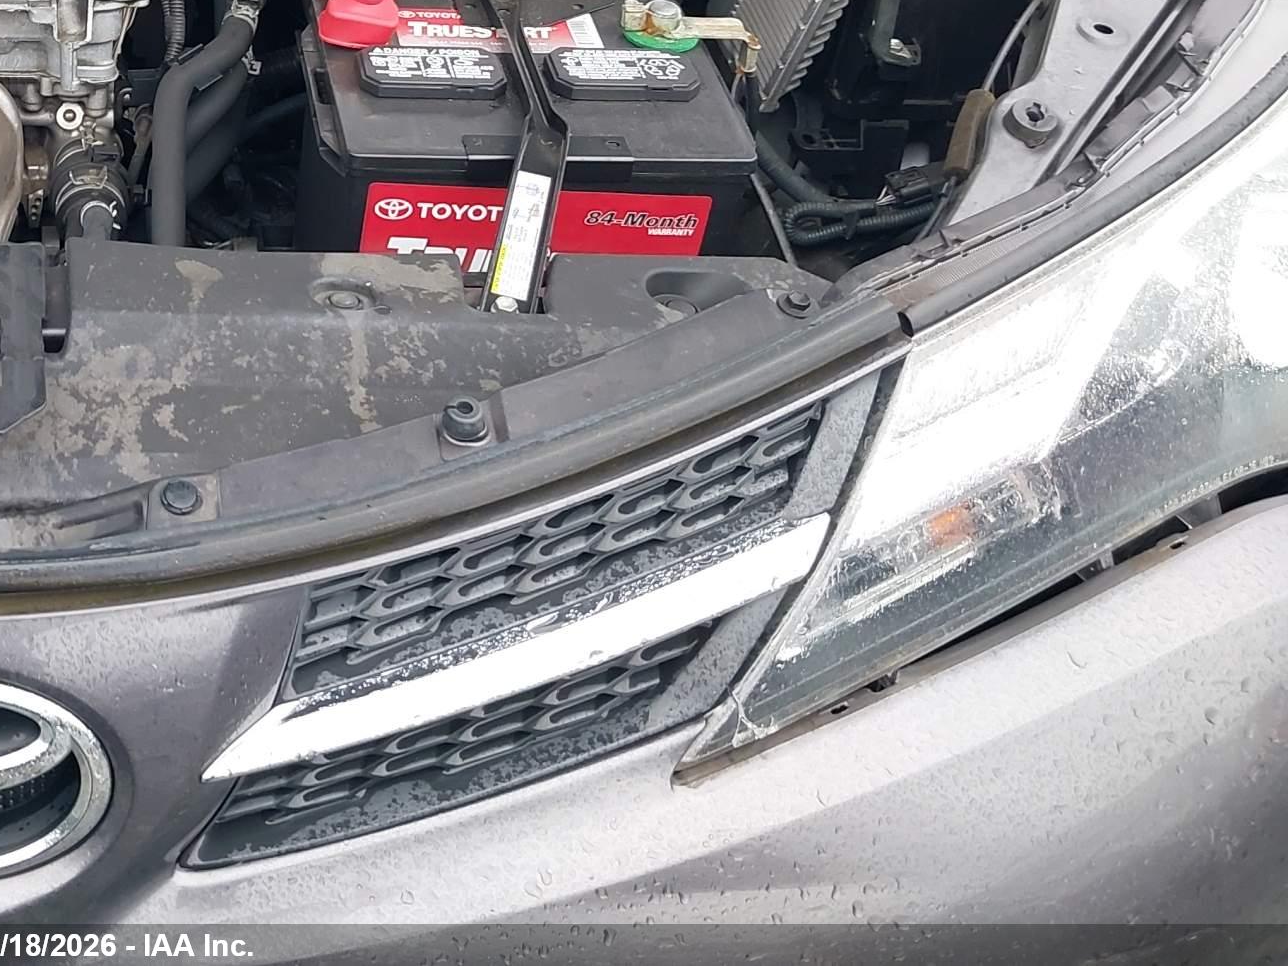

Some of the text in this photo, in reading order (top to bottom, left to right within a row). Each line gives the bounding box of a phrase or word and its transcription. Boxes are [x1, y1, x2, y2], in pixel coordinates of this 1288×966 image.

[416, 202, 504, 222] TOYOT
[584, 210, 699, 229] 84-Month
[647, 227, 695, 237] WARRANTY
